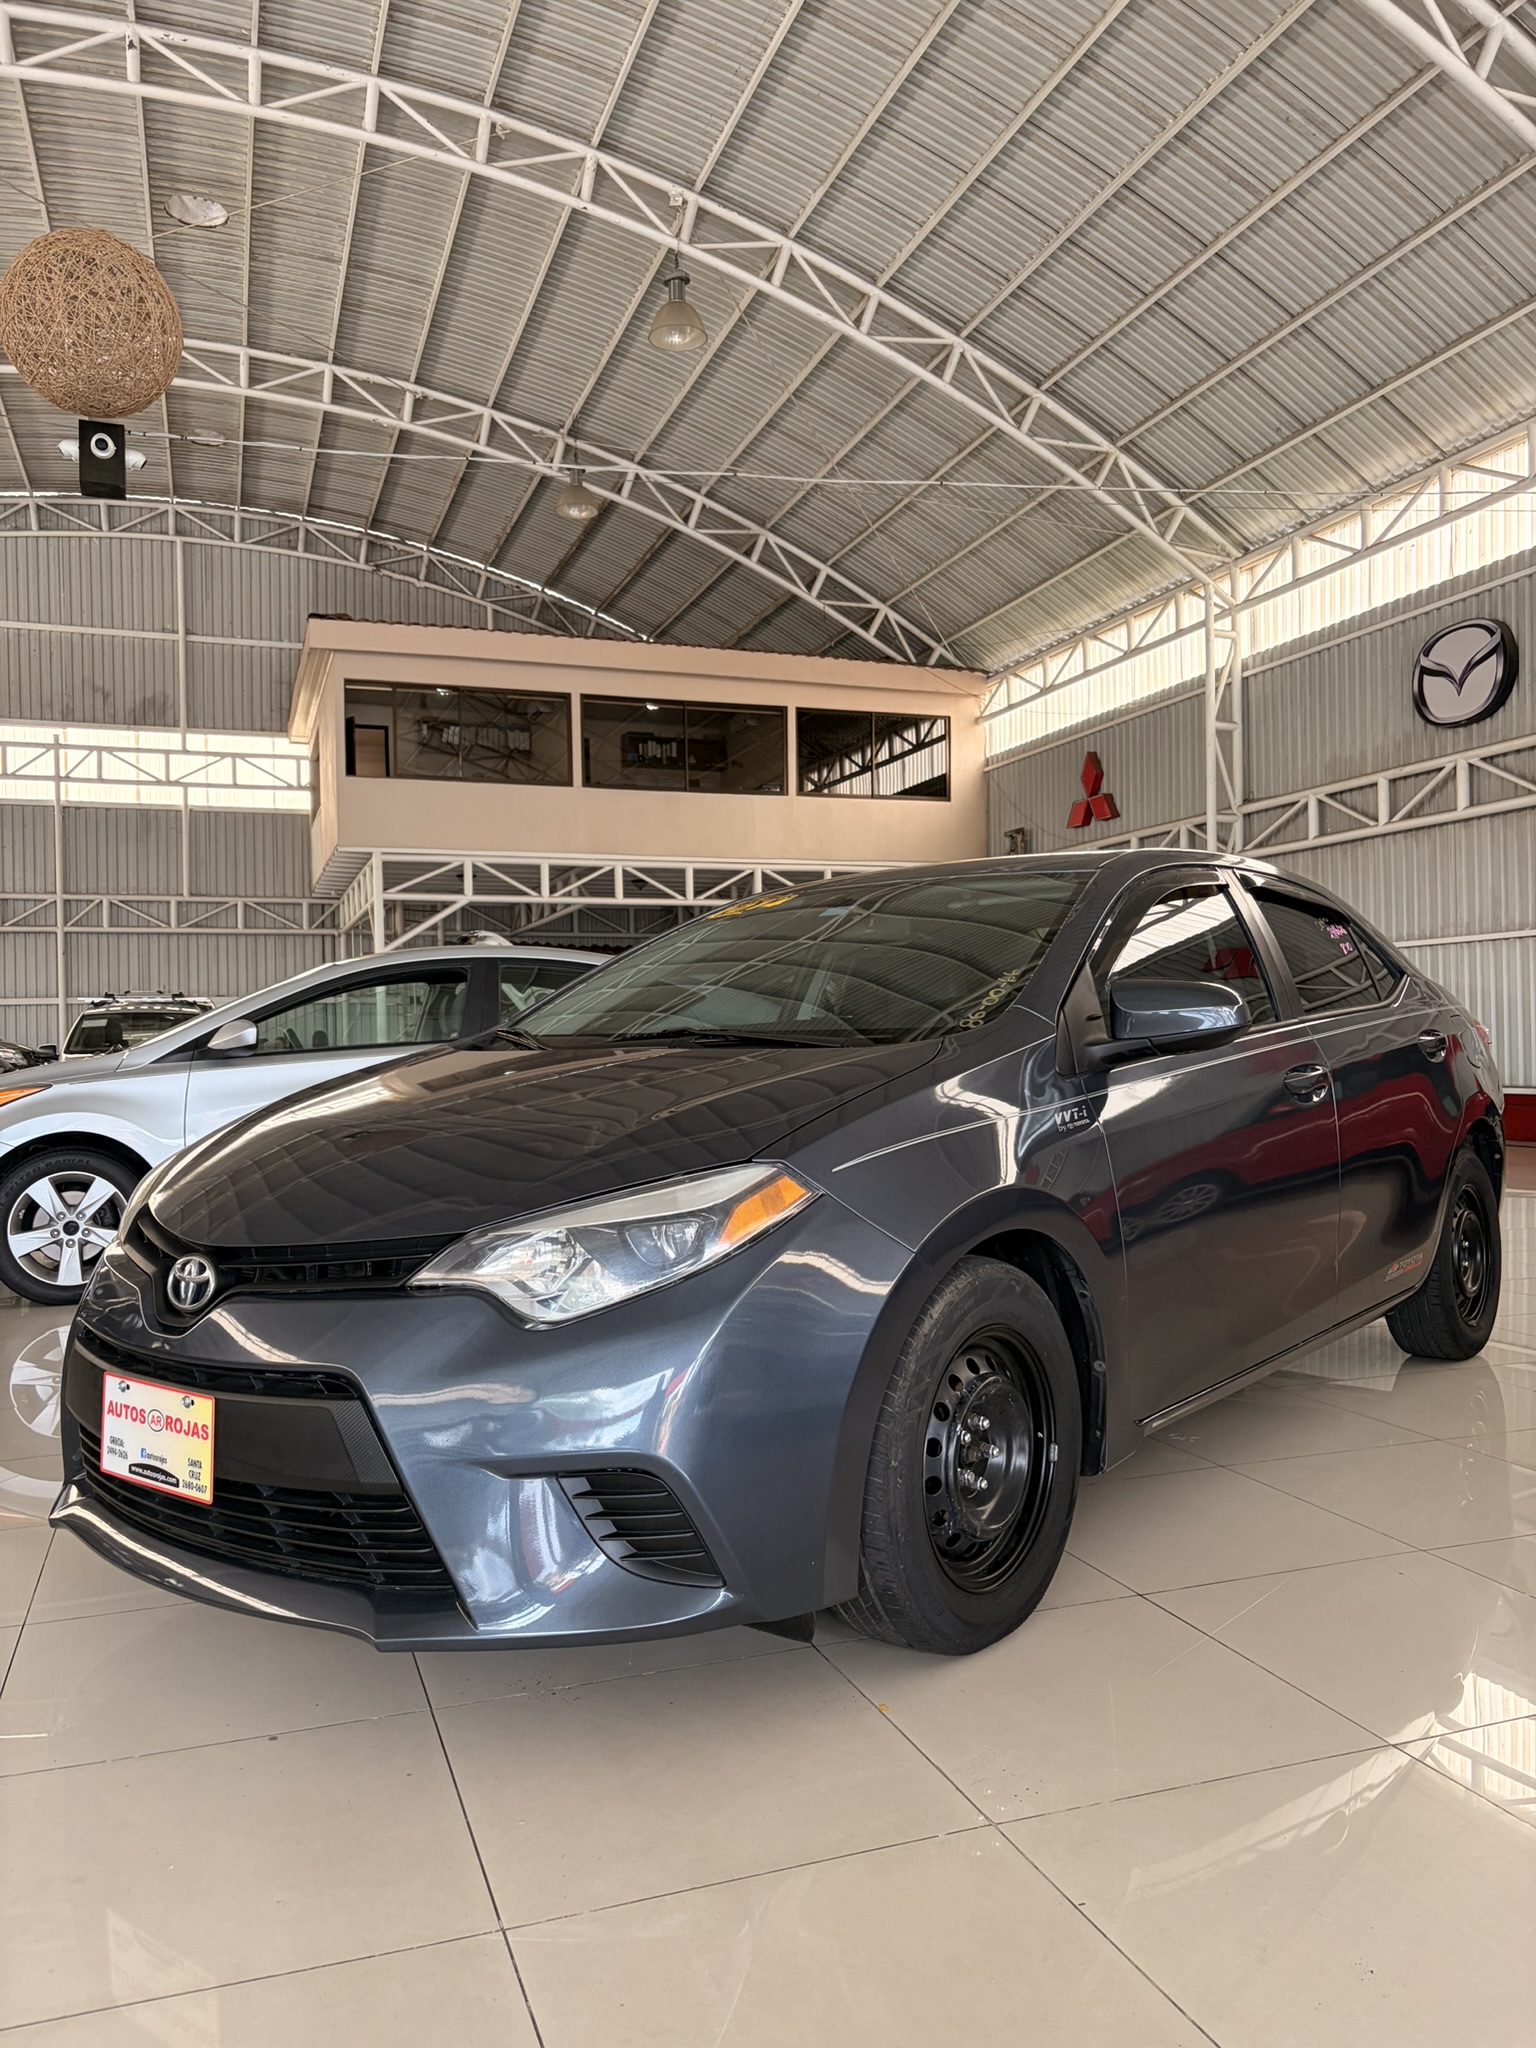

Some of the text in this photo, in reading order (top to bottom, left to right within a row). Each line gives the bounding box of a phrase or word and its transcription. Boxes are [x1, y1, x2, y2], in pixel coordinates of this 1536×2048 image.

[1054, 1105, 1087, 1125] VVT-i
[1057, 1124, 1067, 1133] by
[1399, 1252, 1423, 1269] TOYOTA
[107, 1400, 209, 1441] AUTOS AR ROJAS
[187, 1458, 202, 1469] SANTA
[188, 1469, 201, 1481] CRUZ
